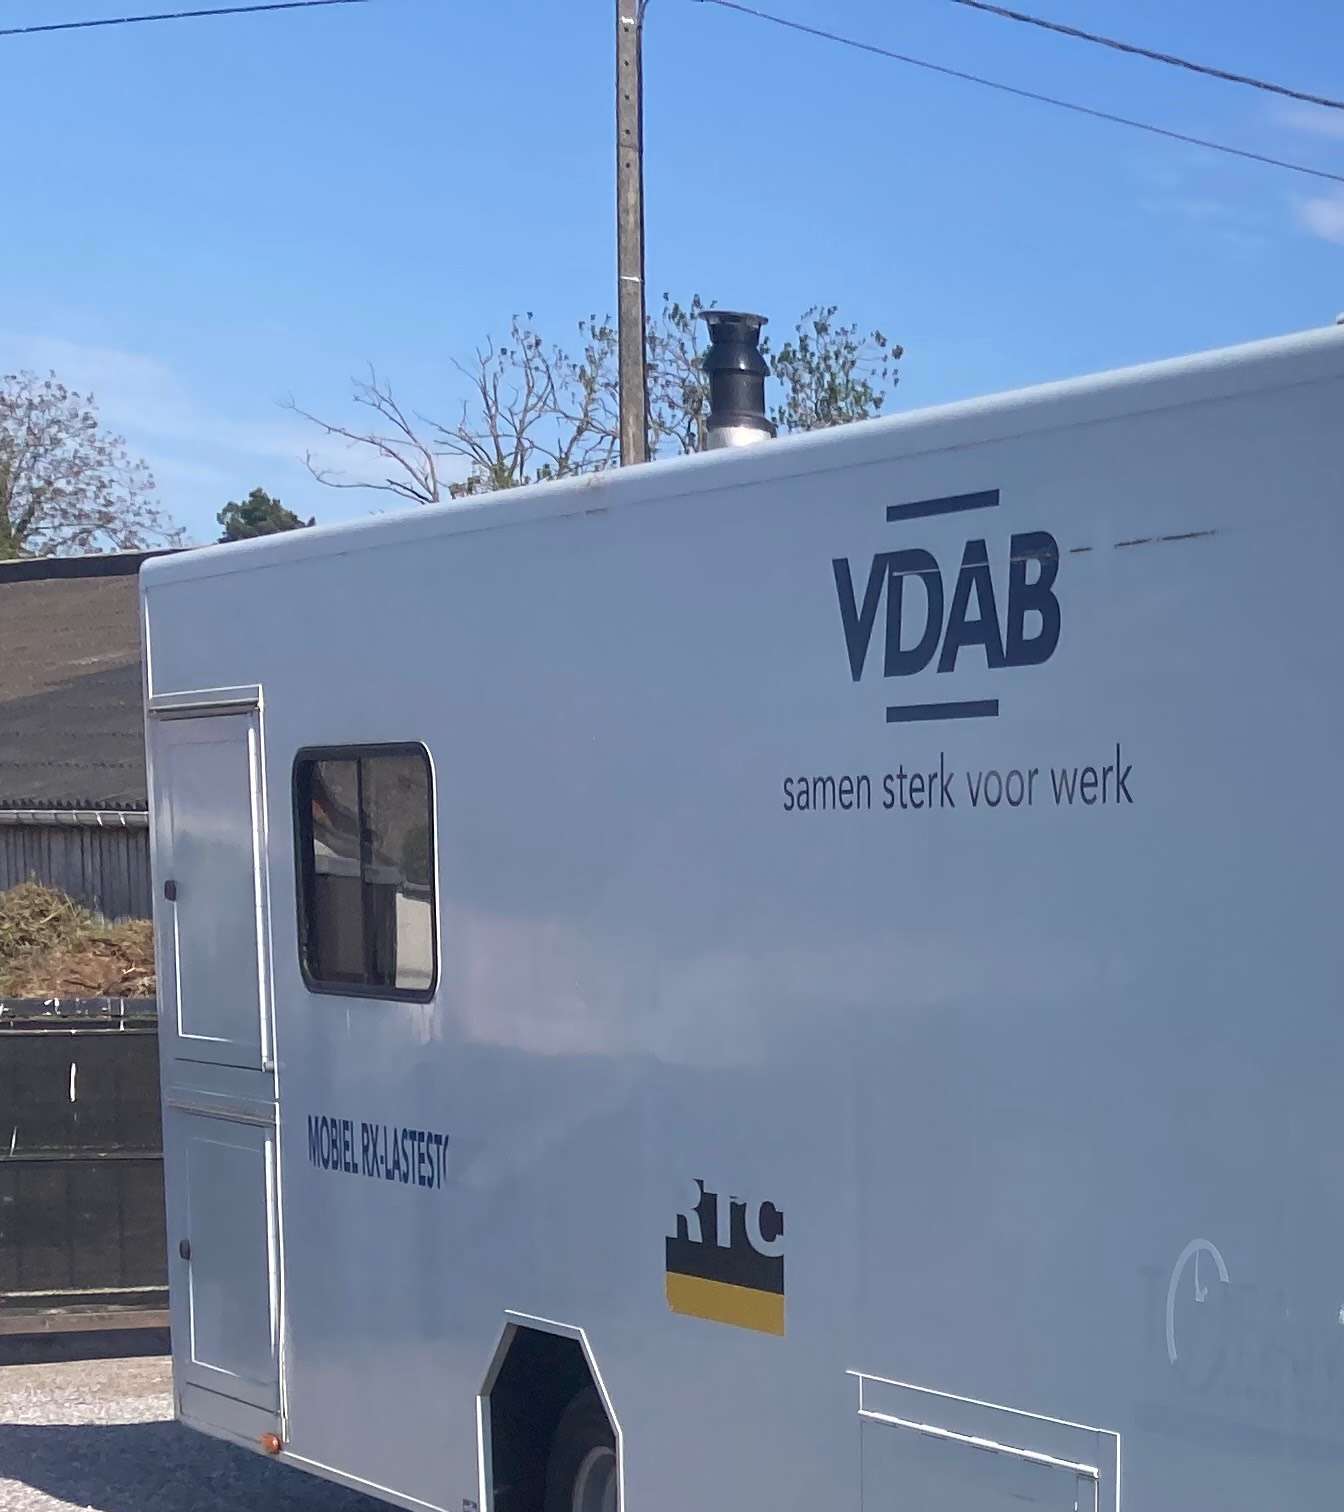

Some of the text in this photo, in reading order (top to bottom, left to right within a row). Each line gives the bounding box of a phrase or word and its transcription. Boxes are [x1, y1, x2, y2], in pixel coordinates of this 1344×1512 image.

[832, 529, 1062, 683] VDAB
[782, 741, 1135, 812] samen sterk voor werk
[307, 1114, 359, 1175] MOBIEL
